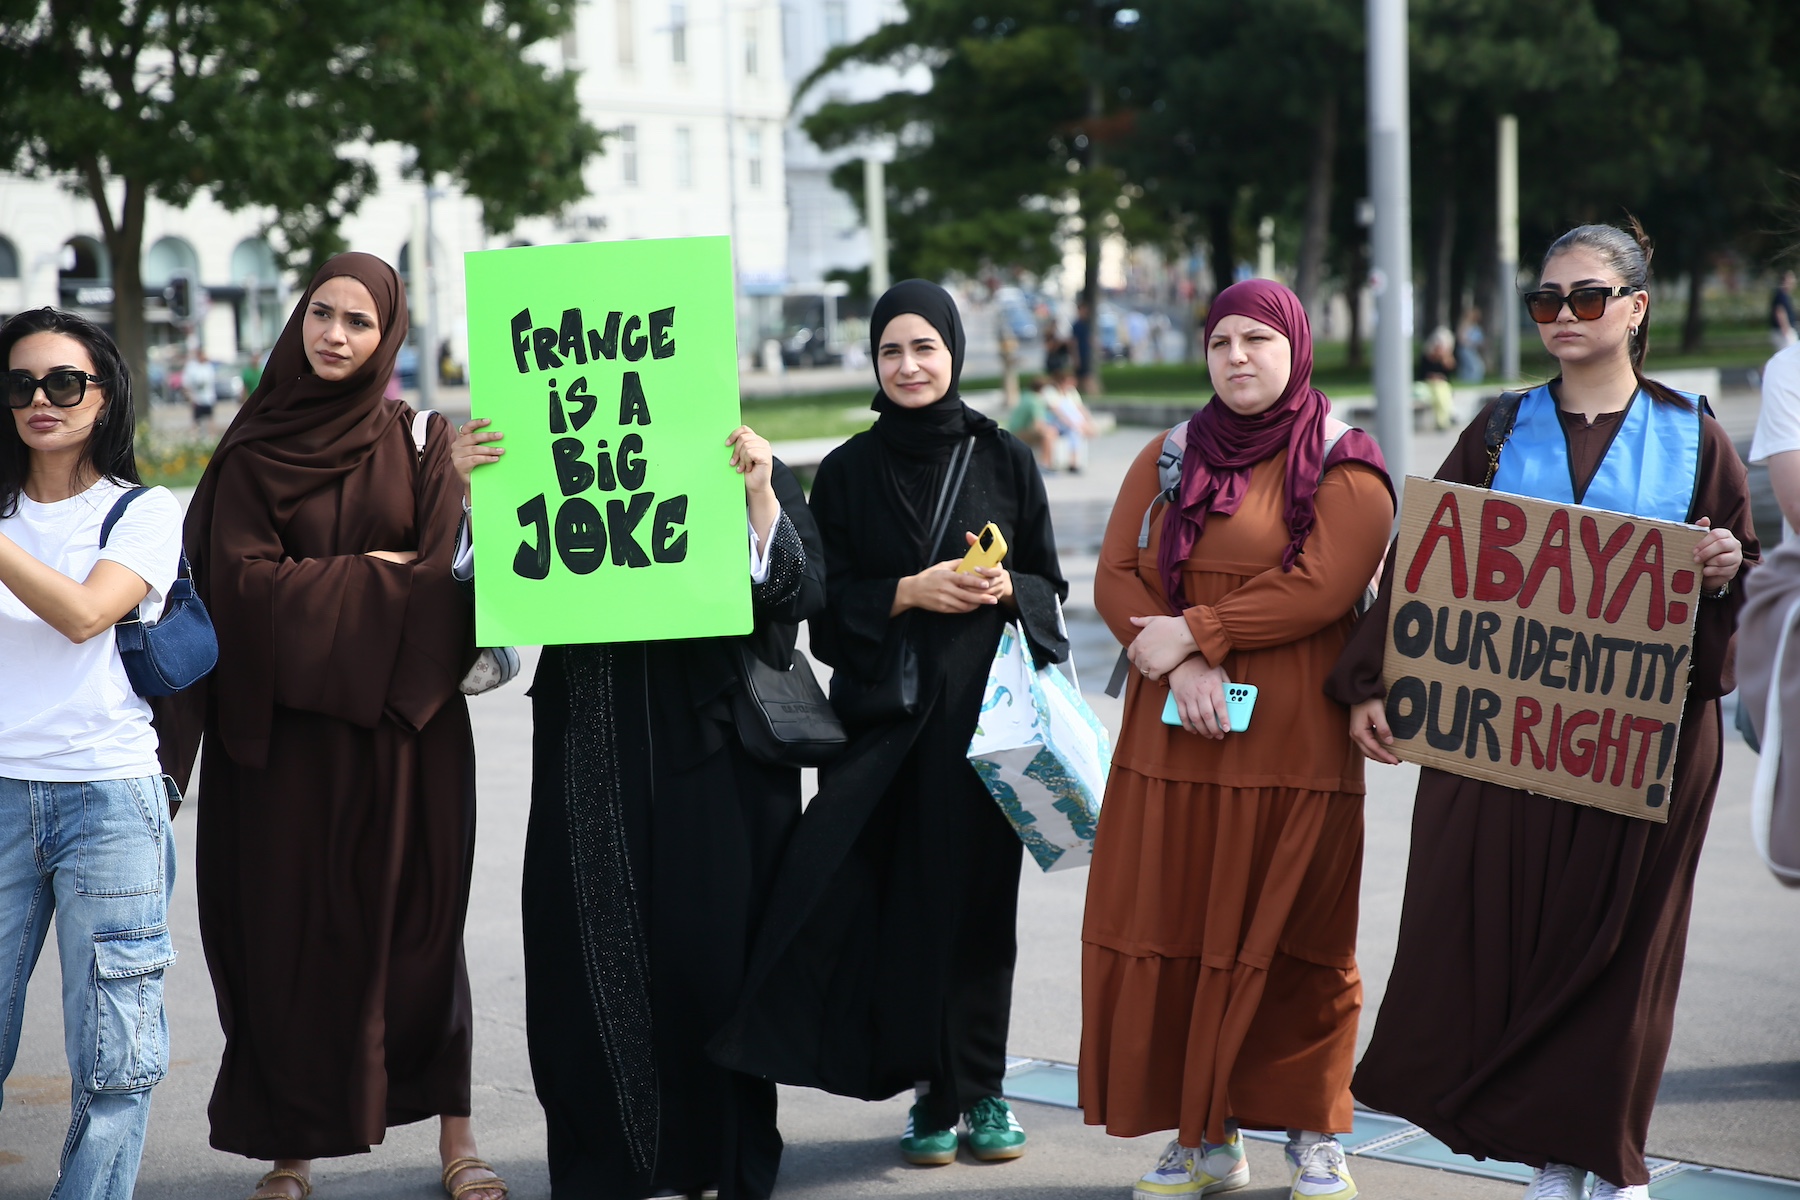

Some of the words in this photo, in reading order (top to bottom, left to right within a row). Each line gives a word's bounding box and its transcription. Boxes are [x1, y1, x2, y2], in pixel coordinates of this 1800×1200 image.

[511, 306, 676, 373] FRANCE
[618, 371, 652, 426] A
[512, 491, 689, 580] JOKE
[1405, 491, 1695, 632] ABAYA:
[1393, 600, 1502, 675] OUR
[1507, 615, 1690, 705] IDENTITY
[1385, 675, 1503, 763] OUR
[1510, 695, 1677, 808] RIGHT!
